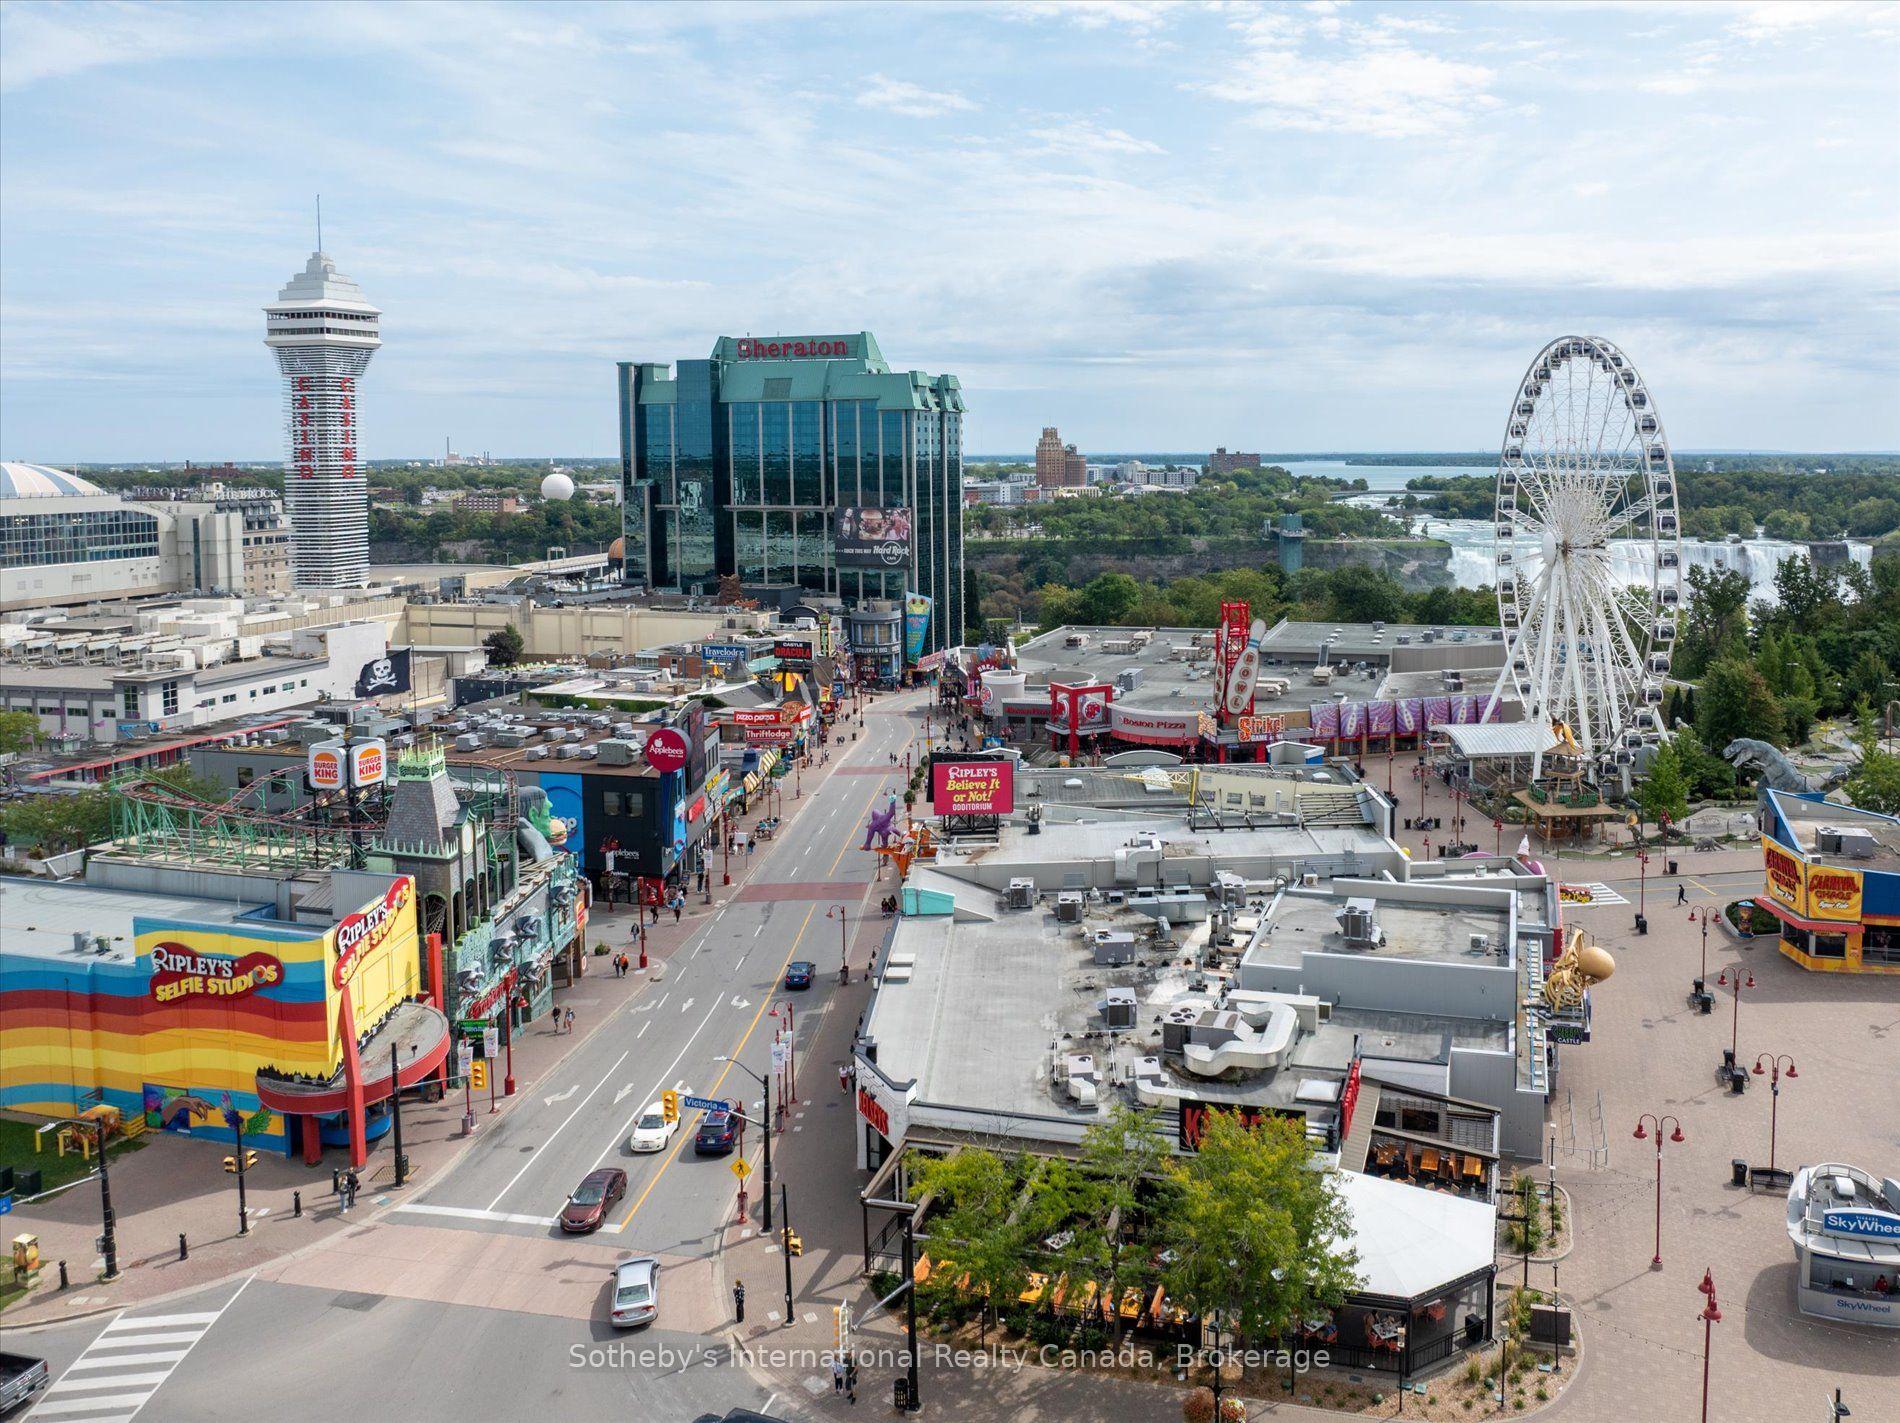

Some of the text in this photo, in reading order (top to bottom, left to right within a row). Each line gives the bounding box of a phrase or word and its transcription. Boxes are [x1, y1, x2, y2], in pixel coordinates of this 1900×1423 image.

[737, 338, 849, 359] Sheraton
[297, 376, 314, 480] CASINO
[341, 376, 356, 480] CASINO
[873, 545, 892, 555] Hard
[892, 545, 910, 556] Rock
[775, 648, 811, 658] DRACULA
[736, 713, 775, 722] pizza pizza
[1123, 717, 1187, 730] Boston Pizza
[1238, 714, 1286, 742] Strike!
[745, 730, 791, 741] Thriftlodge
[1251, 734, 1268, 742] GAME
[313, 761, 338, 769] BURGER
[358, 755, 382, 766] BURGER
[314, 768, 338, 779] KING
[358, 764, 382, 777] KING
[948, 766, 998, 780] RIPLEY'S
[946, 778, 1001, 791] Believe It
[953, 790, 993, 803] or Not!
[952, 803, 993, 811] ODDITORIUM
[1766, 848, 1801, 885] CARNIVAL
[1770, 868, 1797, 892] CHAOS
[1809, 875, 1860, 893] CARNIVAL
[1560, 892, 1591, 904] Hot Dogs
[1815, 890, 1854, 900] CHAOS
[338, 902, 388, 957] RIPLEY'S
[150, 946, 234, 979] RIPLEY'S
[341, 935, 371, 985] SELFIE
[155, 964, 278, 1002] SELFIE STUDIOS
[1557, 1037, 1580, 1045] CASTLE
[685, 1097, 718, 1110] Victoria
[1827, 1215, 1900, 1234] SkyWhee
[1836, 1299, 1891, 1313] SkyWheel
